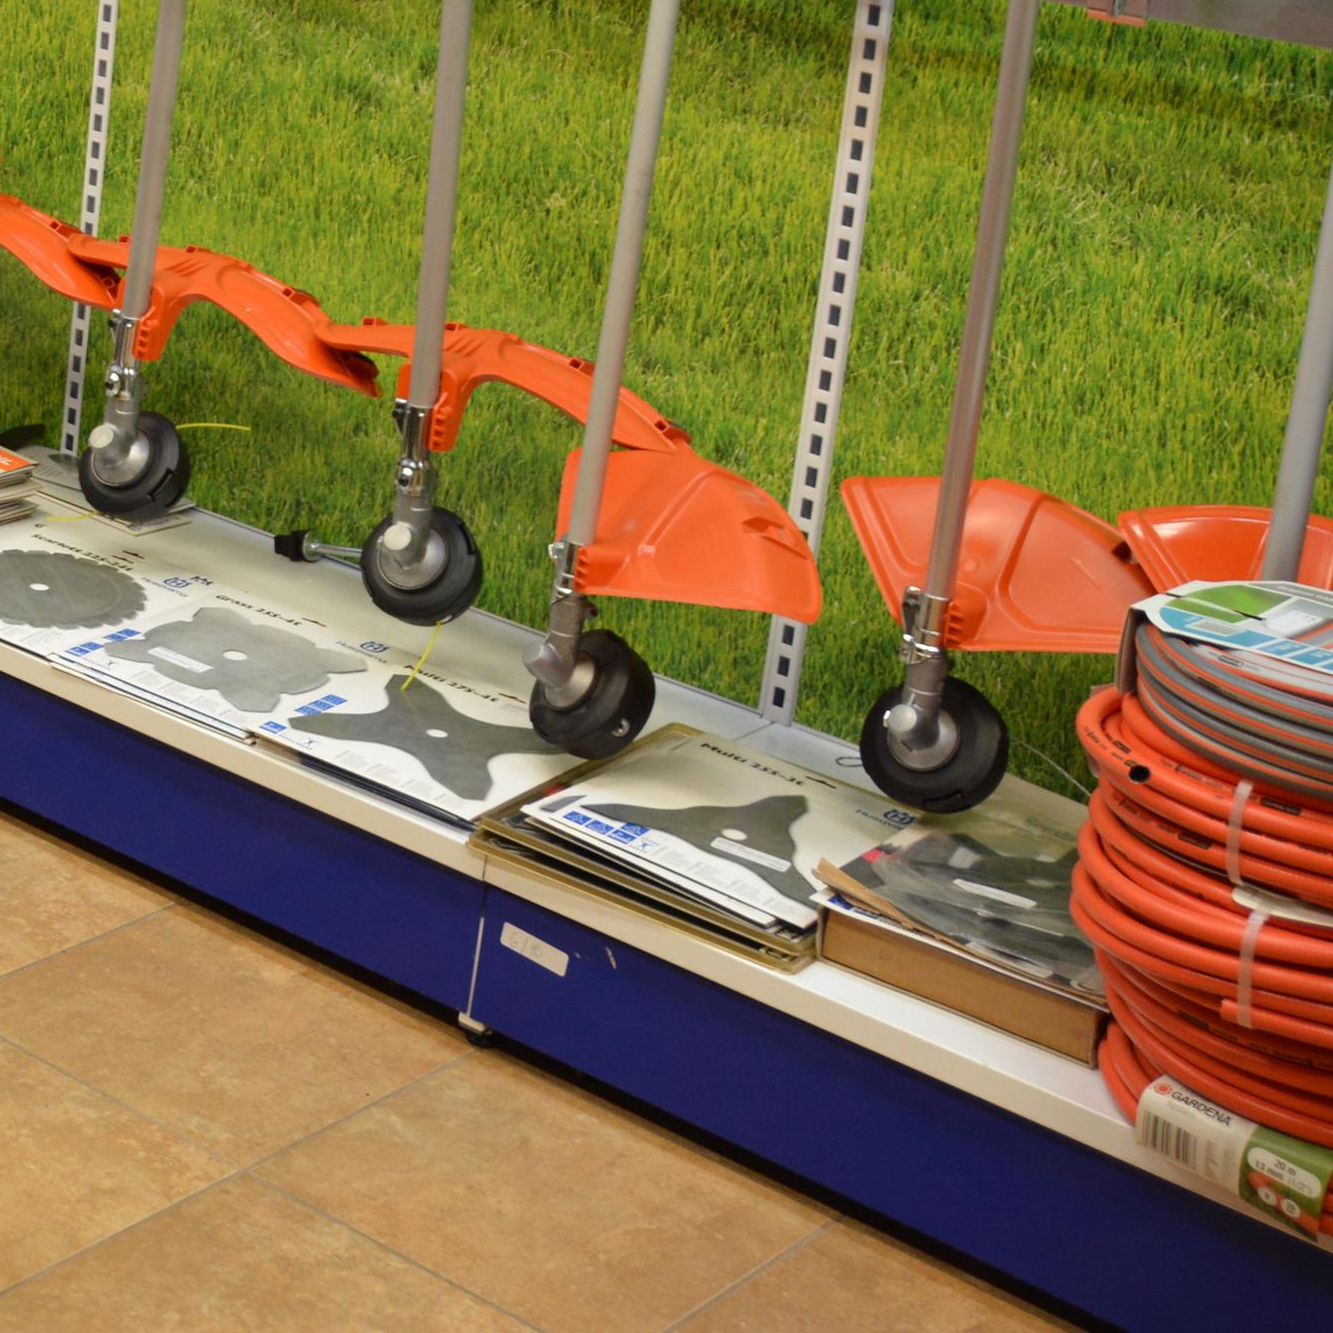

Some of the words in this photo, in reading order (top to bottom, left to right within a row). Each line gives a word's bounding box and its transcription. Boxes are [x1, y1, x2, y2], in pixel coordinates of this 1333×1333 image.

[215, 593, 253, 610] Grass
[700, 742, 747, 764] Multi
[1172, 1089, 1233, 1127] GARDENA
